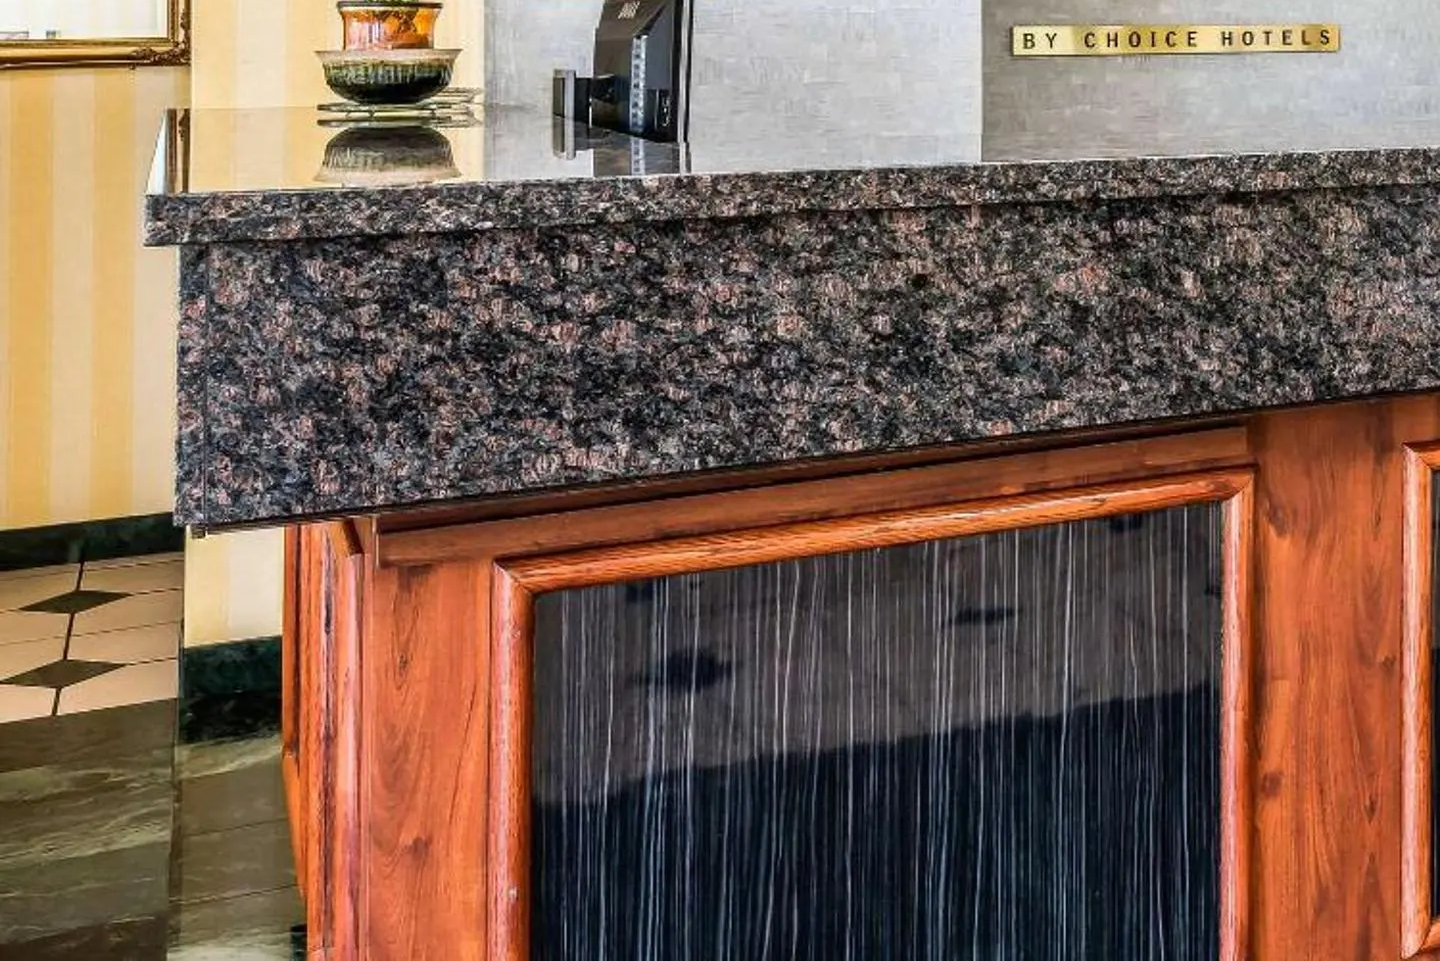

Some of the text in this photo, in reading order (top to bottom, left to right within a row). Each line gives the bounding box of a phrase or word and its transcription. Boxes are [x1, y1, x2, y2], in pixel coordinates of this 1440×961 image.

[1022, 29, 1330, 50] BY CHOICE HOTELS
